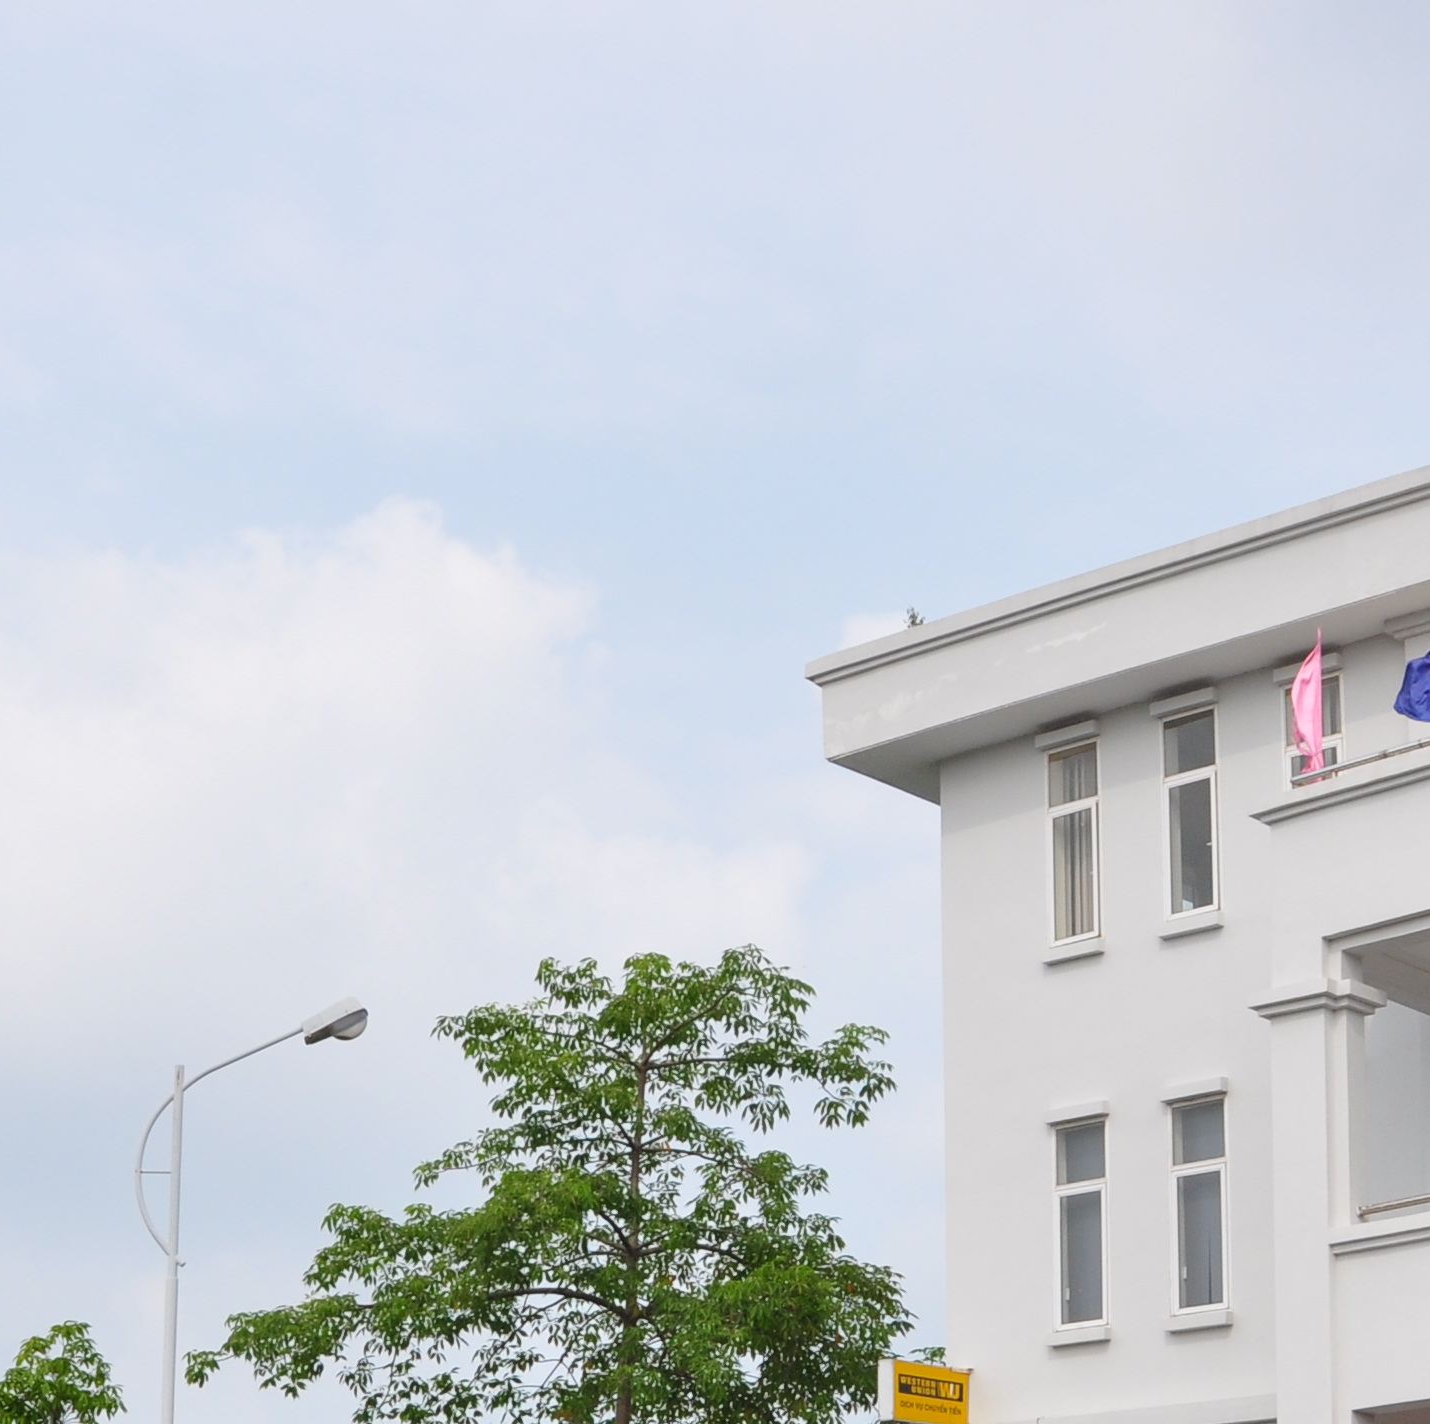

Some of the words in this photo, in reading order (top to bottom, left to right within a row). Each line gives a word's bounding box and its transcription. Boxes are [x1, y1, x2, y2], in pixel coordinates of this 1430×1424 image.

[900, 1376, 936, 1387] WESTERN
[911, 1385, 936, 1396] UNION
[940, 1381, 960, 1399] WU
